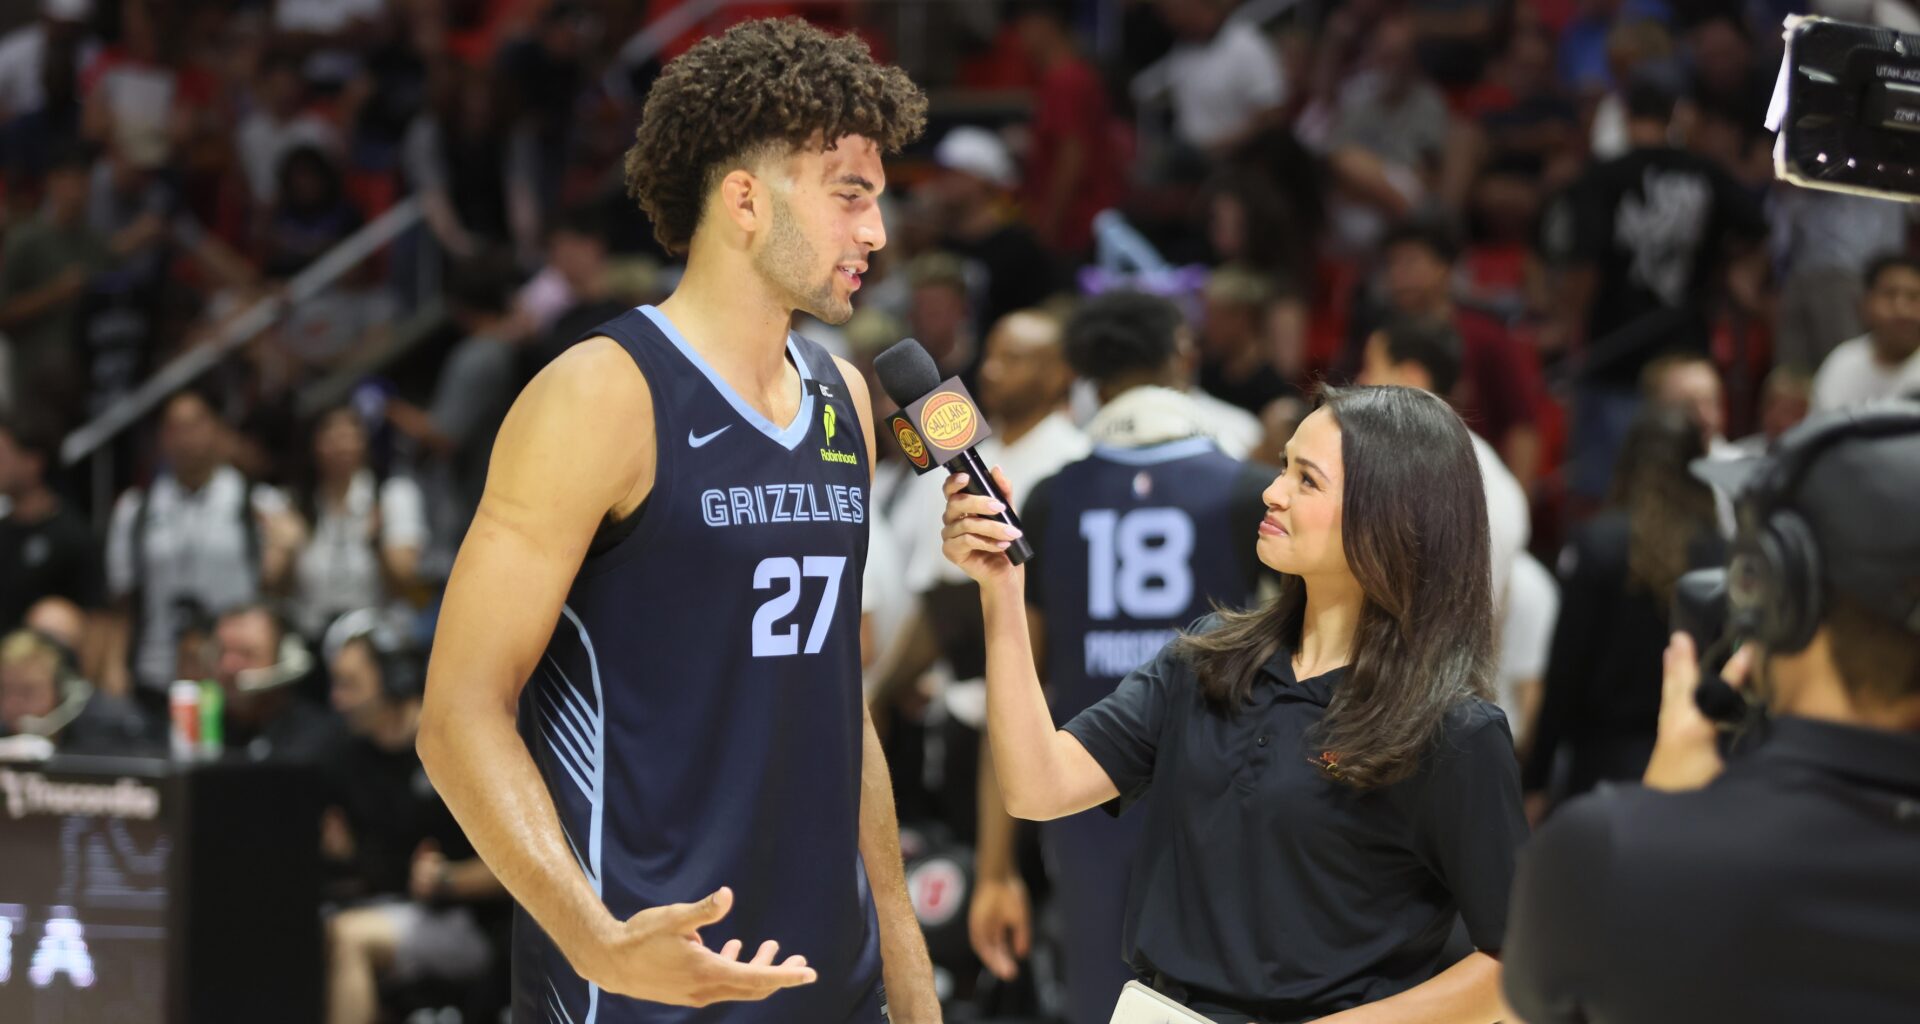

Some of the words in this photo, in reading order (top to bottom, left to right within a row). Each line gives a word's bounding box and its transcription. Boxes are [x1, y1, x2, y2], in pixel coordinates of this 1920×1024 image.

[1875, 66, 1900, 78] UTAH
[929, 410, 947, 434] SALT
[942, 404, 968, 422] LAKE
[944, 420, 963, 435] City
[820, 448, 857, 465] Robinhood
[701, 484, 864, 526] GRIZZLIES
[1080, 507, 1194, 620] 18
[752, 556, 847, 657] 27
